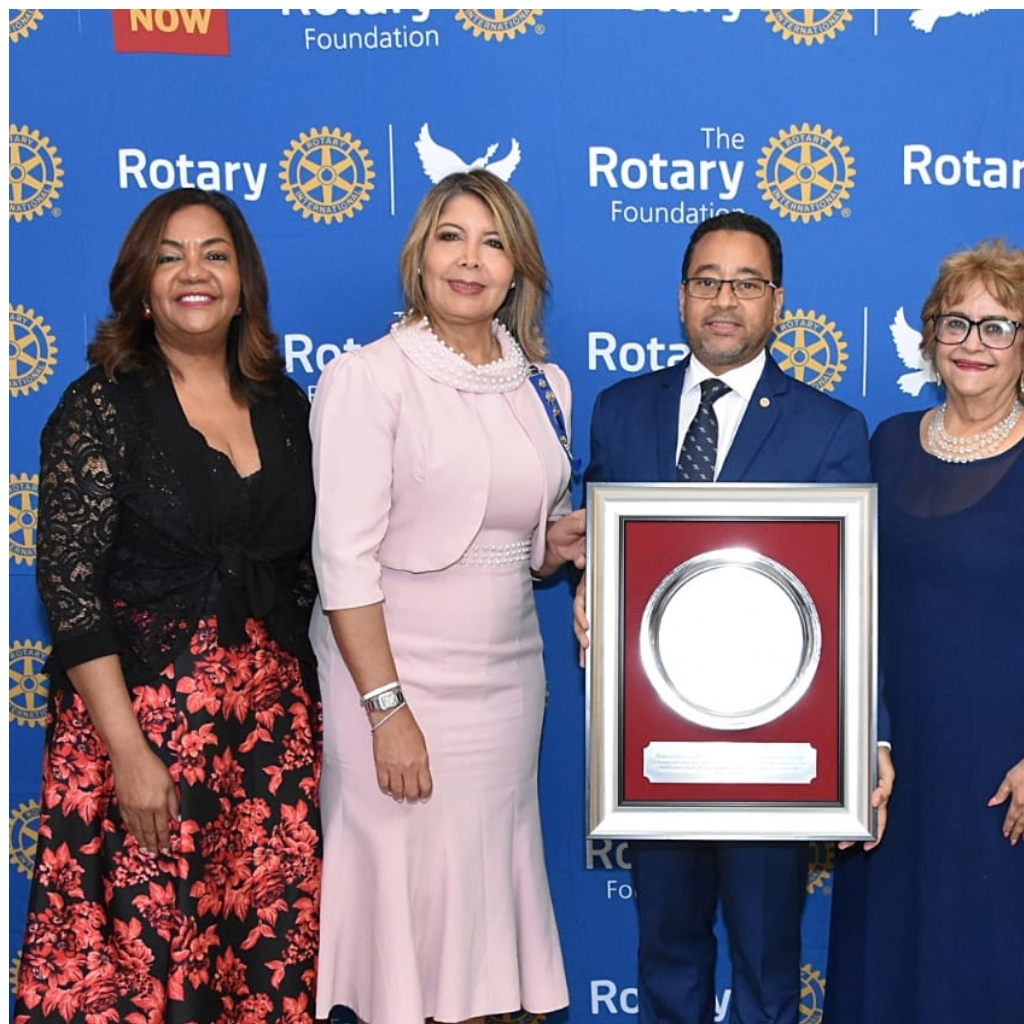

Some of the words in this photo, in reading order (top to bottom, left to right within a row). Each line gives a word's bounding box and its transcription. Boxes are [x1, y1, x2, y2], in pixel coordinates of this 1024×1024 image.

[304, 25, 439, 50] Foundation
[306, 137, 345, 149] ROTARY
[701, 127, 745, 150] The
[785, 135, 826, 147] ROTARY
[118, 148, 267, 201] Rotary
[588, 146, 744, 200] Rotary
[295, 190, 361, 213] INTERNATIONAL
[611, 200, 745, 224] Foundati
[772, 188, 841, 212] INTERNATIONAL
[587, 331, 691, 372] Rota
